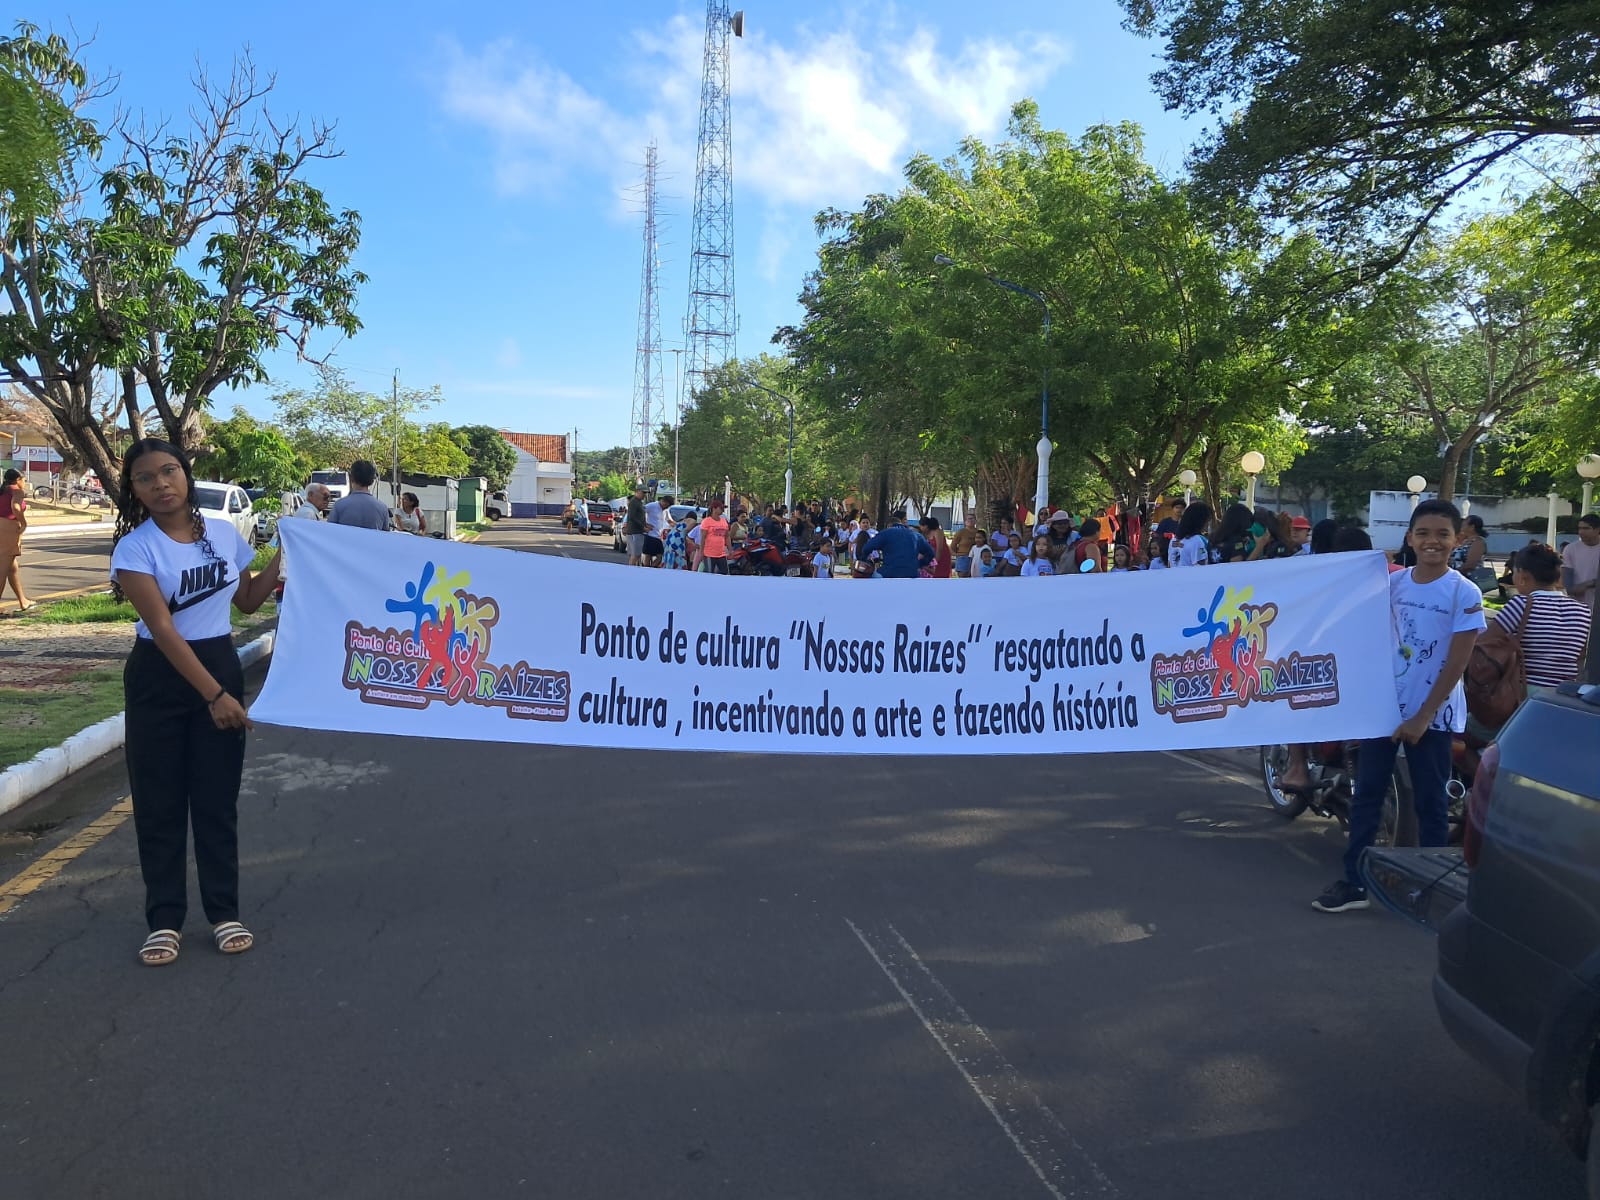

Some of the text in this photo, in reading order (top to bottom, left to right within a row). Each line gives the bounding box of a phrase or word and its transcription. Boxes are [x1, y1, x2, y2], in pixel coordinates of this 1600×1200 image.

[179, 560, 228, 597] NIKE
[350, 628, 432, 661] Ponto de Cult
[581, 602, 650, 661] Ponto
[659, 611, 687, 664] de
[696, 616, 780, 670] cultura
[994, 618, 1123, 683] resgatando
[1130, 632, 1146, 663] a
[477, 665, 568, 700] RAÍZES
[1155, 658, 1181, 676] Ponto
[1183, 656, 1195, 671] de
[1260, 656, 1334, 695] RAÍZES
[578, 677, 668, 728] cultura
[692, 684, 844, 738] incentivando
[852, 705, 867, 738] a
[874, 698, 922, 738] arte
[932, 703, 946, 737] e
[954, 685, 1046, 737] fazendo
[1053, 681, 1139, 732] história
